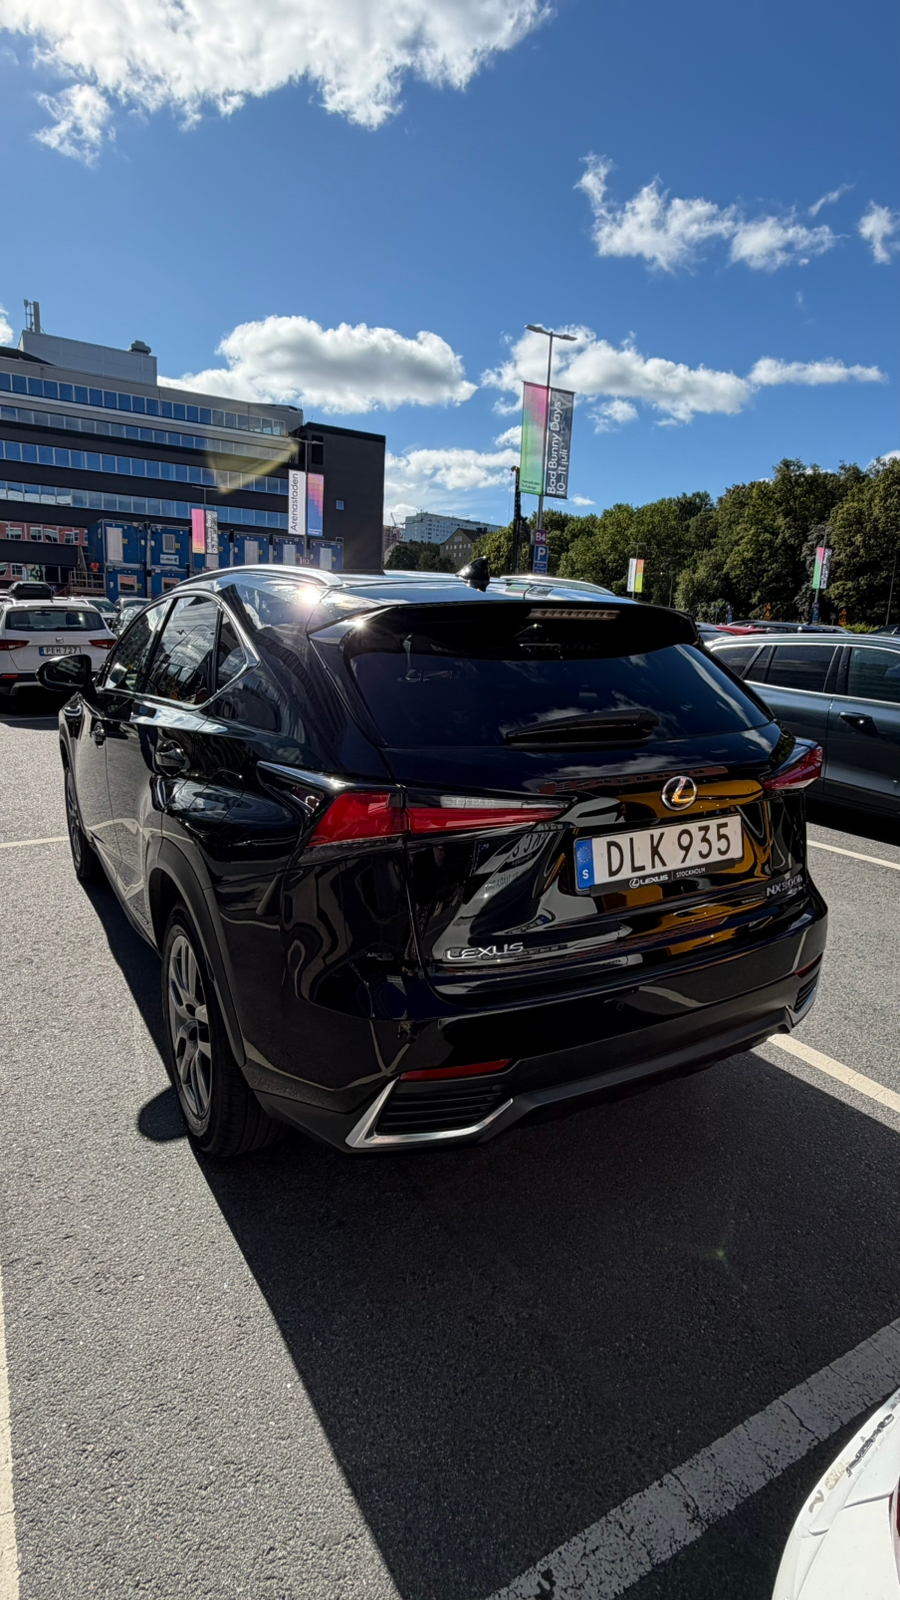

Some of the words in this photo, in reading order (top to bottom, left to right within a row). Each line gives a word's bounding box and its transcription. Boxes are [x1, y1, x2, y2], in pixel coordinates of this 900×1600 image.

[550, 402, 563, 431] Days
[549, 433, 561, 469] Bunny
[560, 449, 569, 465] juli
[547, 471, 557, 494] Bad
[290, 473, 299, 532] Arenastaden
[536, 532, 546, 541] B4
[538, 547, 546, 560] P
[606, 832, 667, 878] DLK
[677, 822, 731, 864] 935
[582, 869, 589, 879] S
[640, 875, 668, 885] LEXUS
[676, 867, 705, 878] STOCKHOLM
[447, 942, 524, 960] LEXUS
